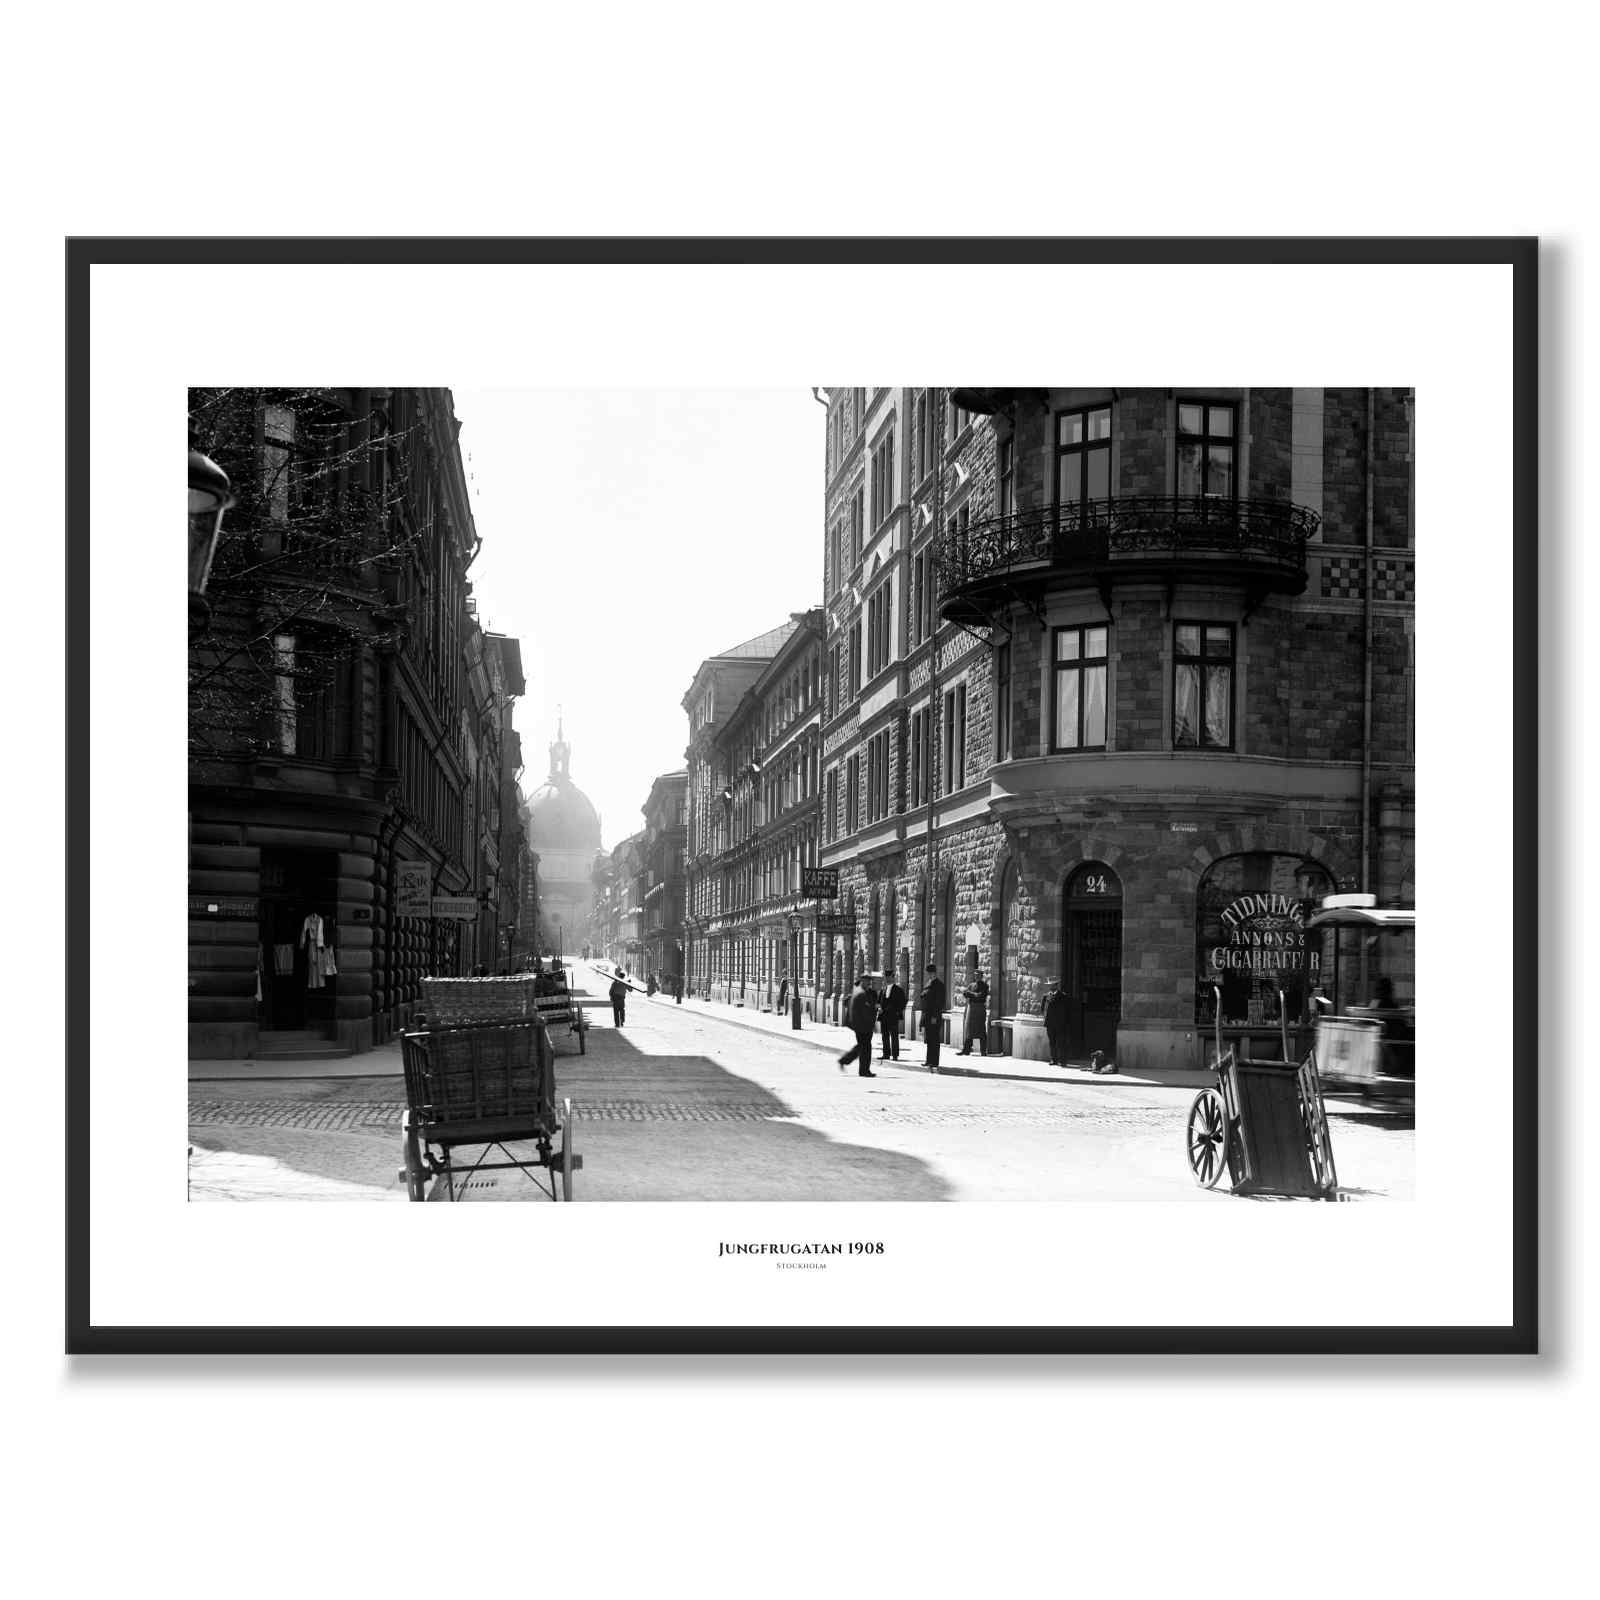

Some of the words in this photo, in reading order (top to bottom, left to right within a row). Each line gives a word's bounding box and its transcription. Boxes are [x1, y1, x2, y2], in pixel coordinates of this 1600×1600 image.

[1086, 875, 1107, 893] 24
[1230, 930, 1295, 946] ANNONS
[719, 1242, 843, 1257] JUNGFRUGATAN
[849, 1242, 885, 1255] 1908
[776, 1262, 827, 1270] STOCKHOLM
